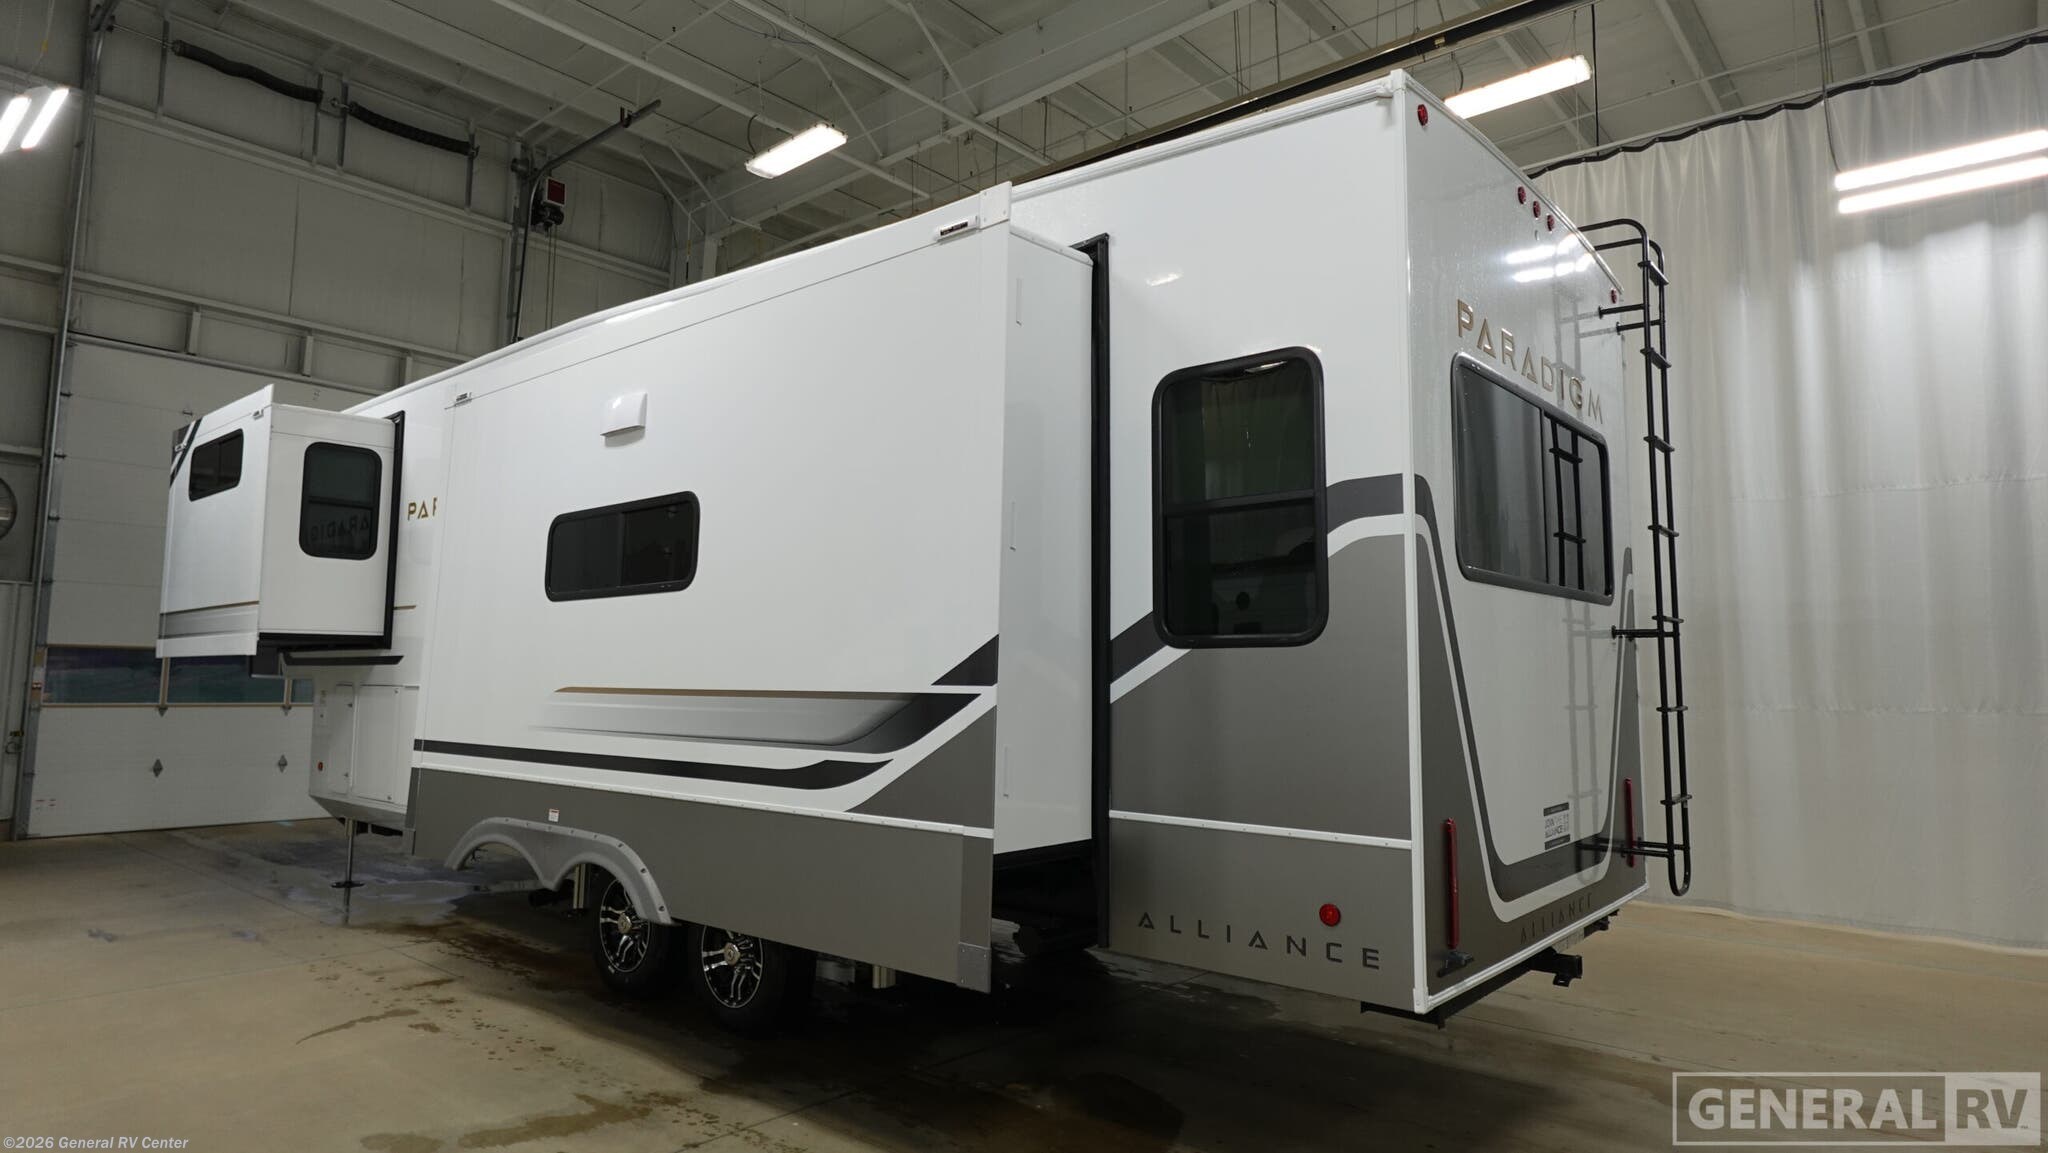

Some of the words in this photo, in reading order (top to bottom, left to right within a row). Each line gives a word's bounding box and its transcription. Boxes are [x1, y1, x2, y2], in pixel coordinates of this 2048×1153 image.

[1457, 298, 1603, 425] PARADIGM
[1138, 911, 1380, 970] ALLIANCE
[1520, 892, 1592, 945] ALLIANCE
